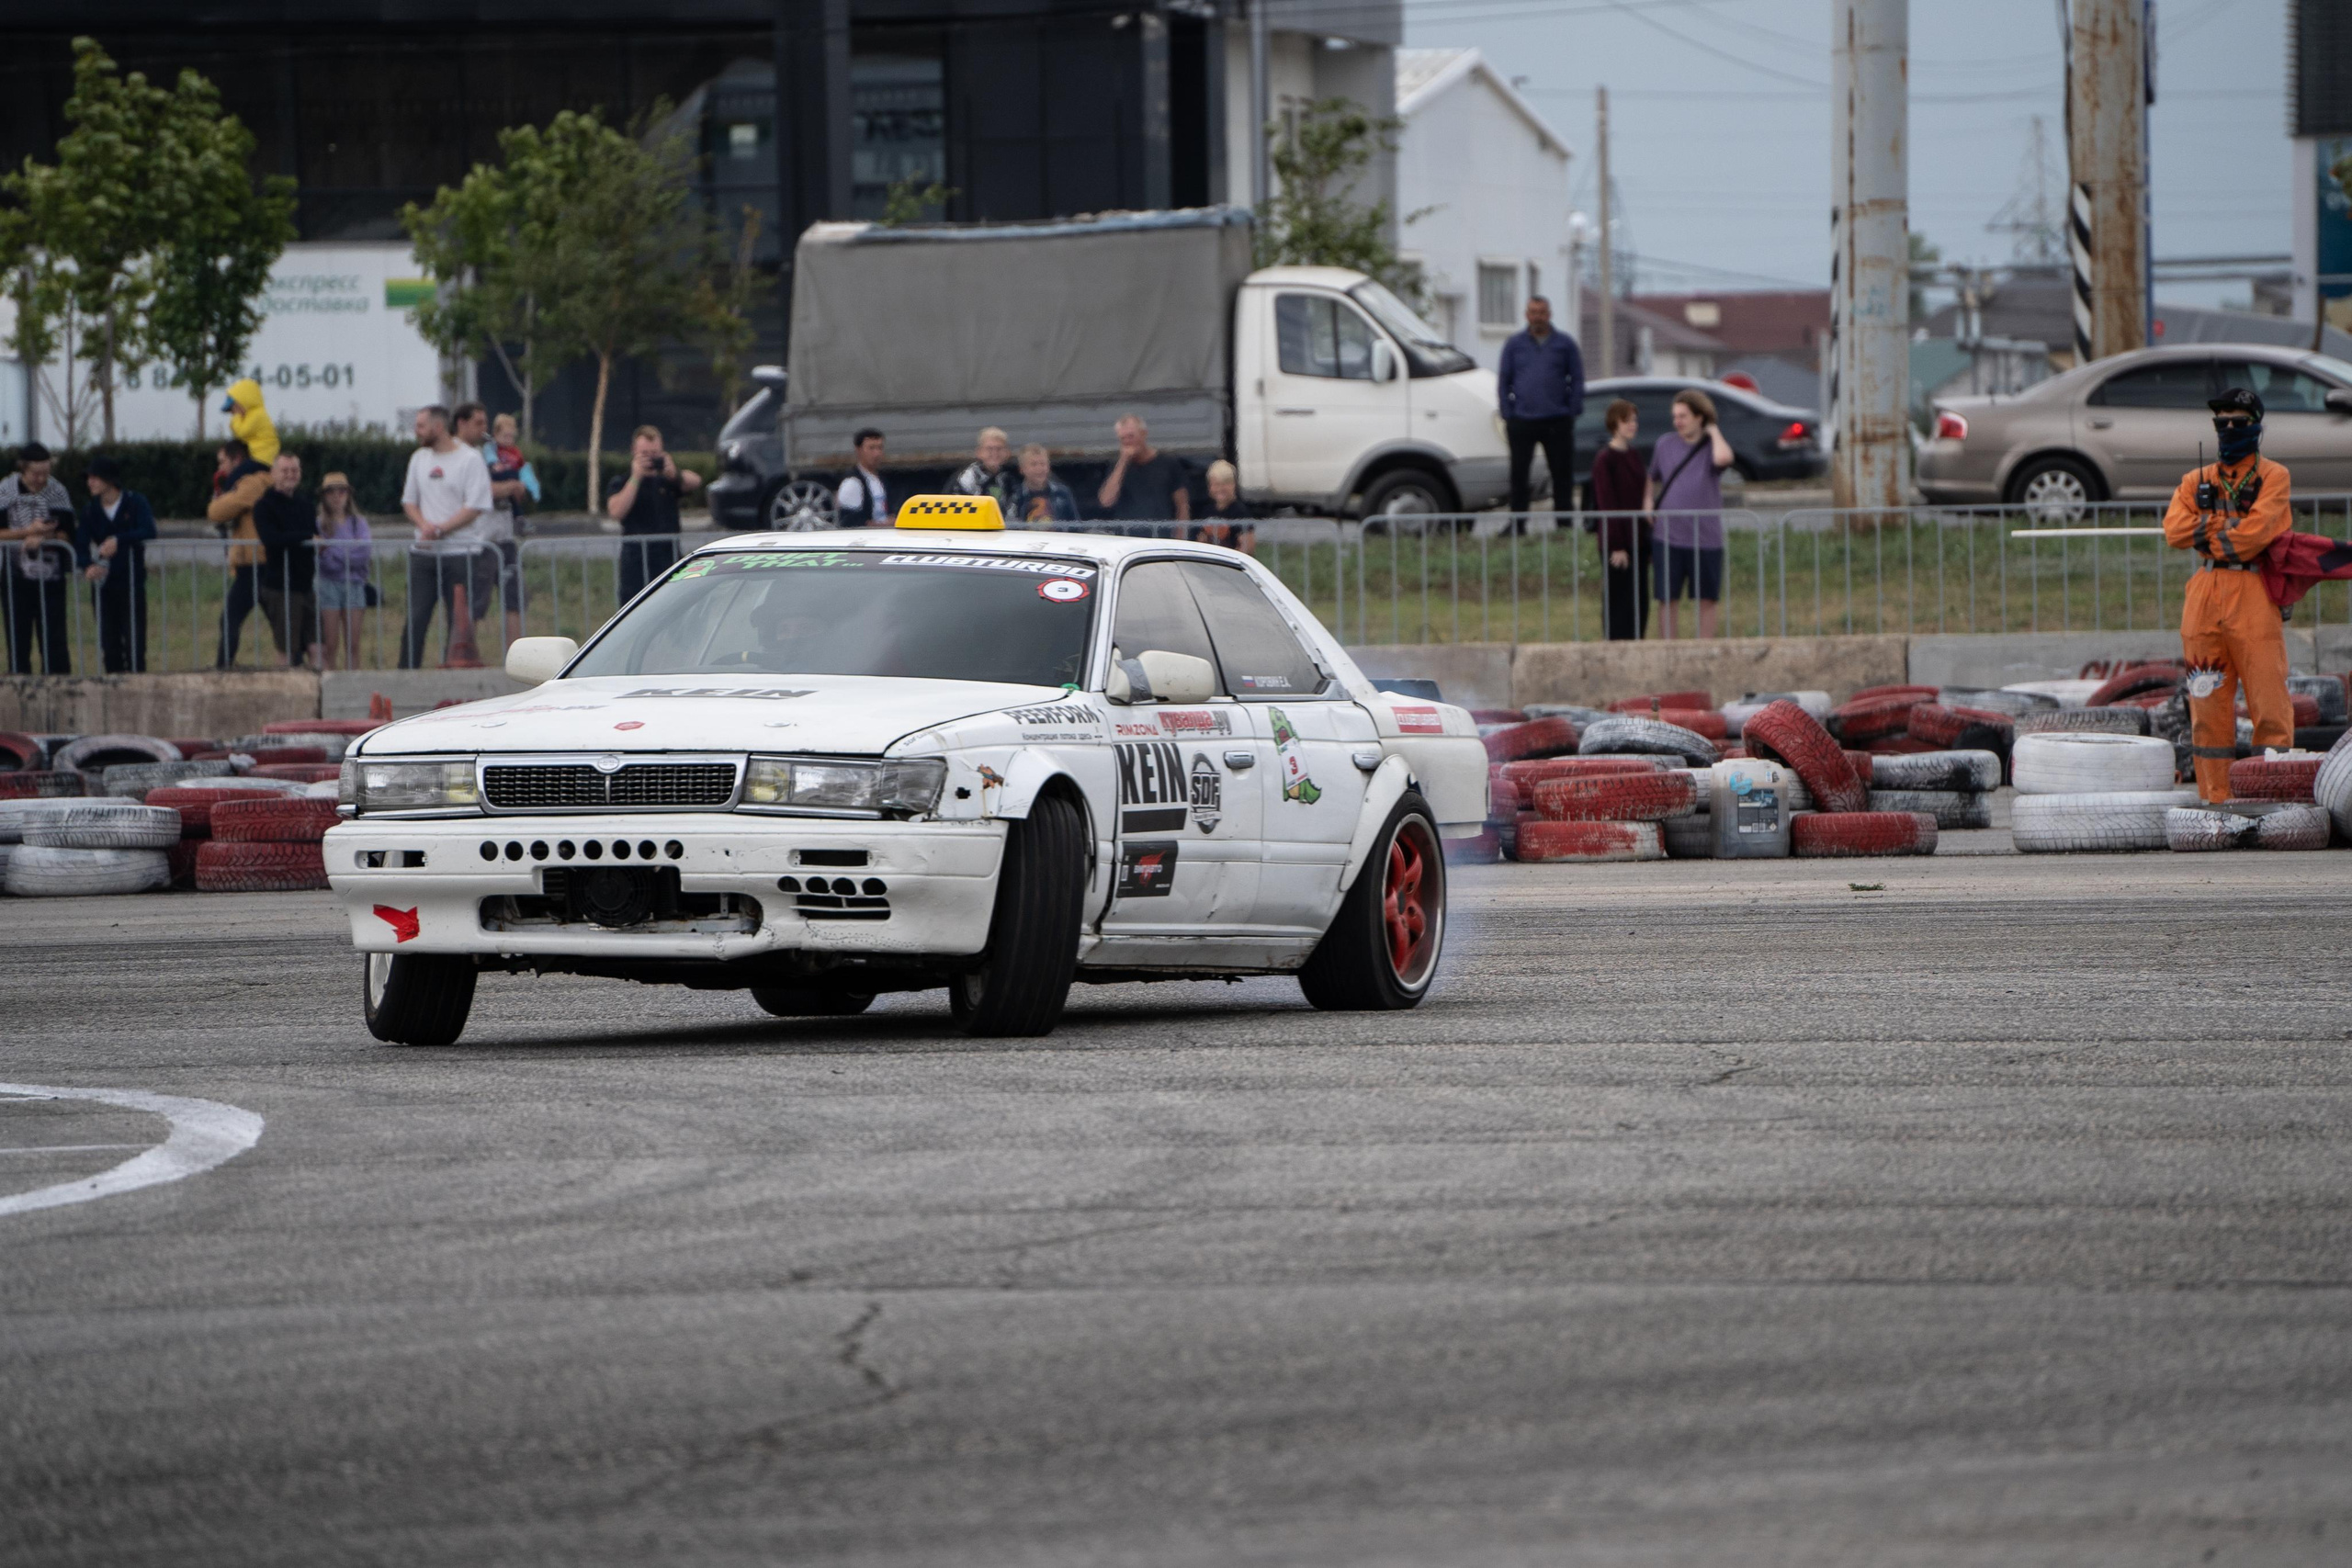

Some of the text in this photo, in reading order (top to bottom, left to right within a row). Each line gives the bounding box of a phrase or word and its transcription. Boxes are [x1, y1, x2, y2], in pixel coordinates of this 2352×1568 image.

[722, 552, 849, 564] DRIFT
[879, 554, 1097, 579] CLUBTURBO
[623, 688, 820, 700] KEIN
[1001, 704, 1101, 725] PEERFORM
[1158, 710, 1233, 737] кувалда.ру
[1114, 724, 1159, 736] RIMZONA
[1114, 742, 1188, 805] KEIN
[1289, 755, 1299, 775] 3
